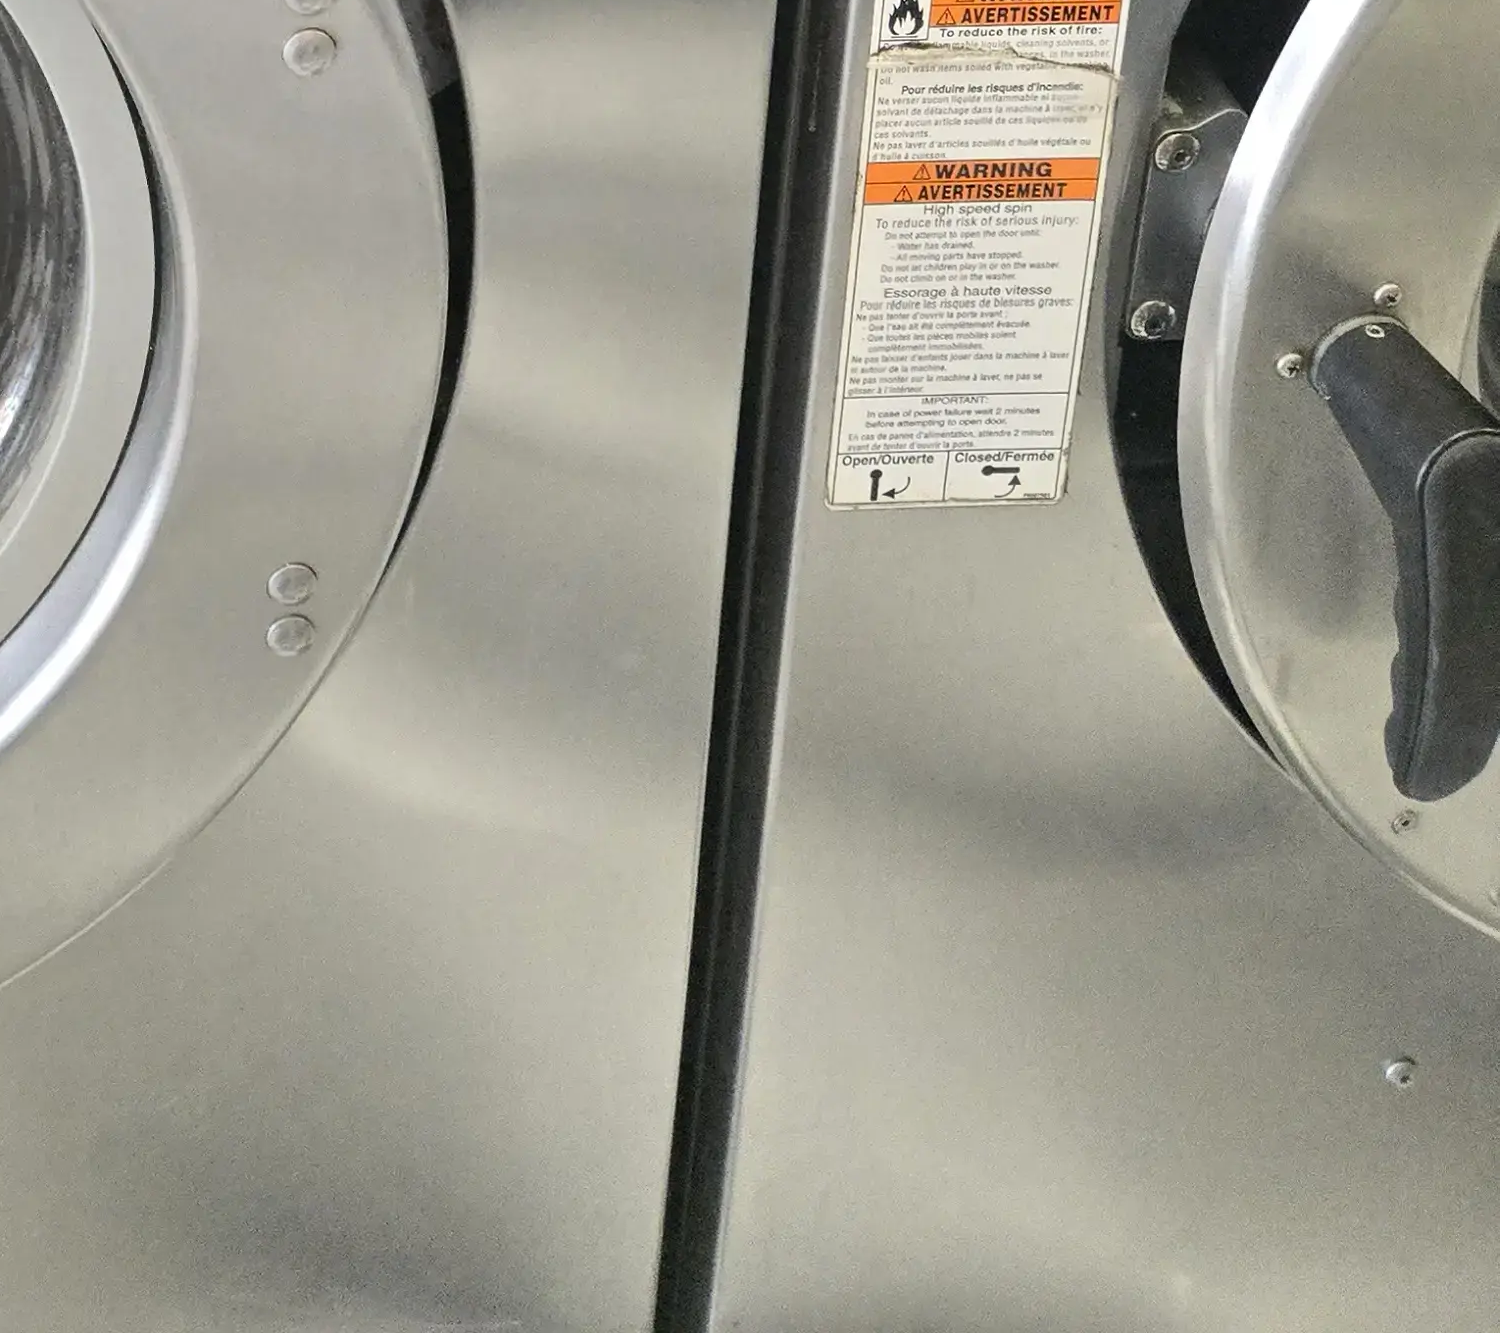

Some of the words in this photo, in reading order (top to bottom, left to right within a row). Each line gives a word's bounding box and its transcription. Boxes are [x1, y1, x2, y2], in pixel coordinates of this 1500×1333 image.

[961, 5, 1115, 23] AVERTISSEMENT
[940, 29, 955, 38] To
[958, 29, 1000, 38] reduce
[1008, 27, 1028, 36] the
[1031, 26, 1055, 35] risk
[1060, 25, 1074, 35] of
[1076, 25, 1102, 35] fire:
[901, 85, 926, 95] Pour
[928, 84, 965, 94] réduire
[968, 83, 983, 93] les
[985, 83, 1024, 93] risques
[935, 162, 1052, 179] WARNING
[918, 183, 1067, 201] AVERTISSEMENT
[924, 205, 954, 218] High
[958, 203, 1000, 216] speed
[1004, 203, 1032, 215] spin
[876, 218, 889, 229] To
[892, 218, 931, 229] reduce
[935, 217, 951, 227] the
[956, 216, 977, 227] risk
[980, 215, 992, 226] of
[996, 215, 1038, 226] serious
[1041, 215, 1079, 227] injury:
[884, 287, 947, 299] Essorage
[951, 286, 959, 297] à
[963, 286, 1001, 297] haute
[1005, 285, 1052, 296] vitesse
[860, 301, 883, 311] Pour
[886, 300, 921, 310] réduire
[923, 299, 937, 309] les
[939, 298, 975, 310] risques
[978, 298, 991, 307] de
[1038, 298, 1074, 308] graves:
[921, 396, 989, 405] IMPORTANT:
[913, 409, 942, 418] power
[944, 408, 972, 416] failure
[1004, 407, 1040, 415] minutes
[897, 419, 945, 429] attempting
[948, 419, 957, 427] to
[959, 419, 982, 427] open
[984, 418, 1007, 426] door.
[842, 455, 934, 468] Open/Ouverte
[955, 450, 1054, 463] Closed/Fermée
